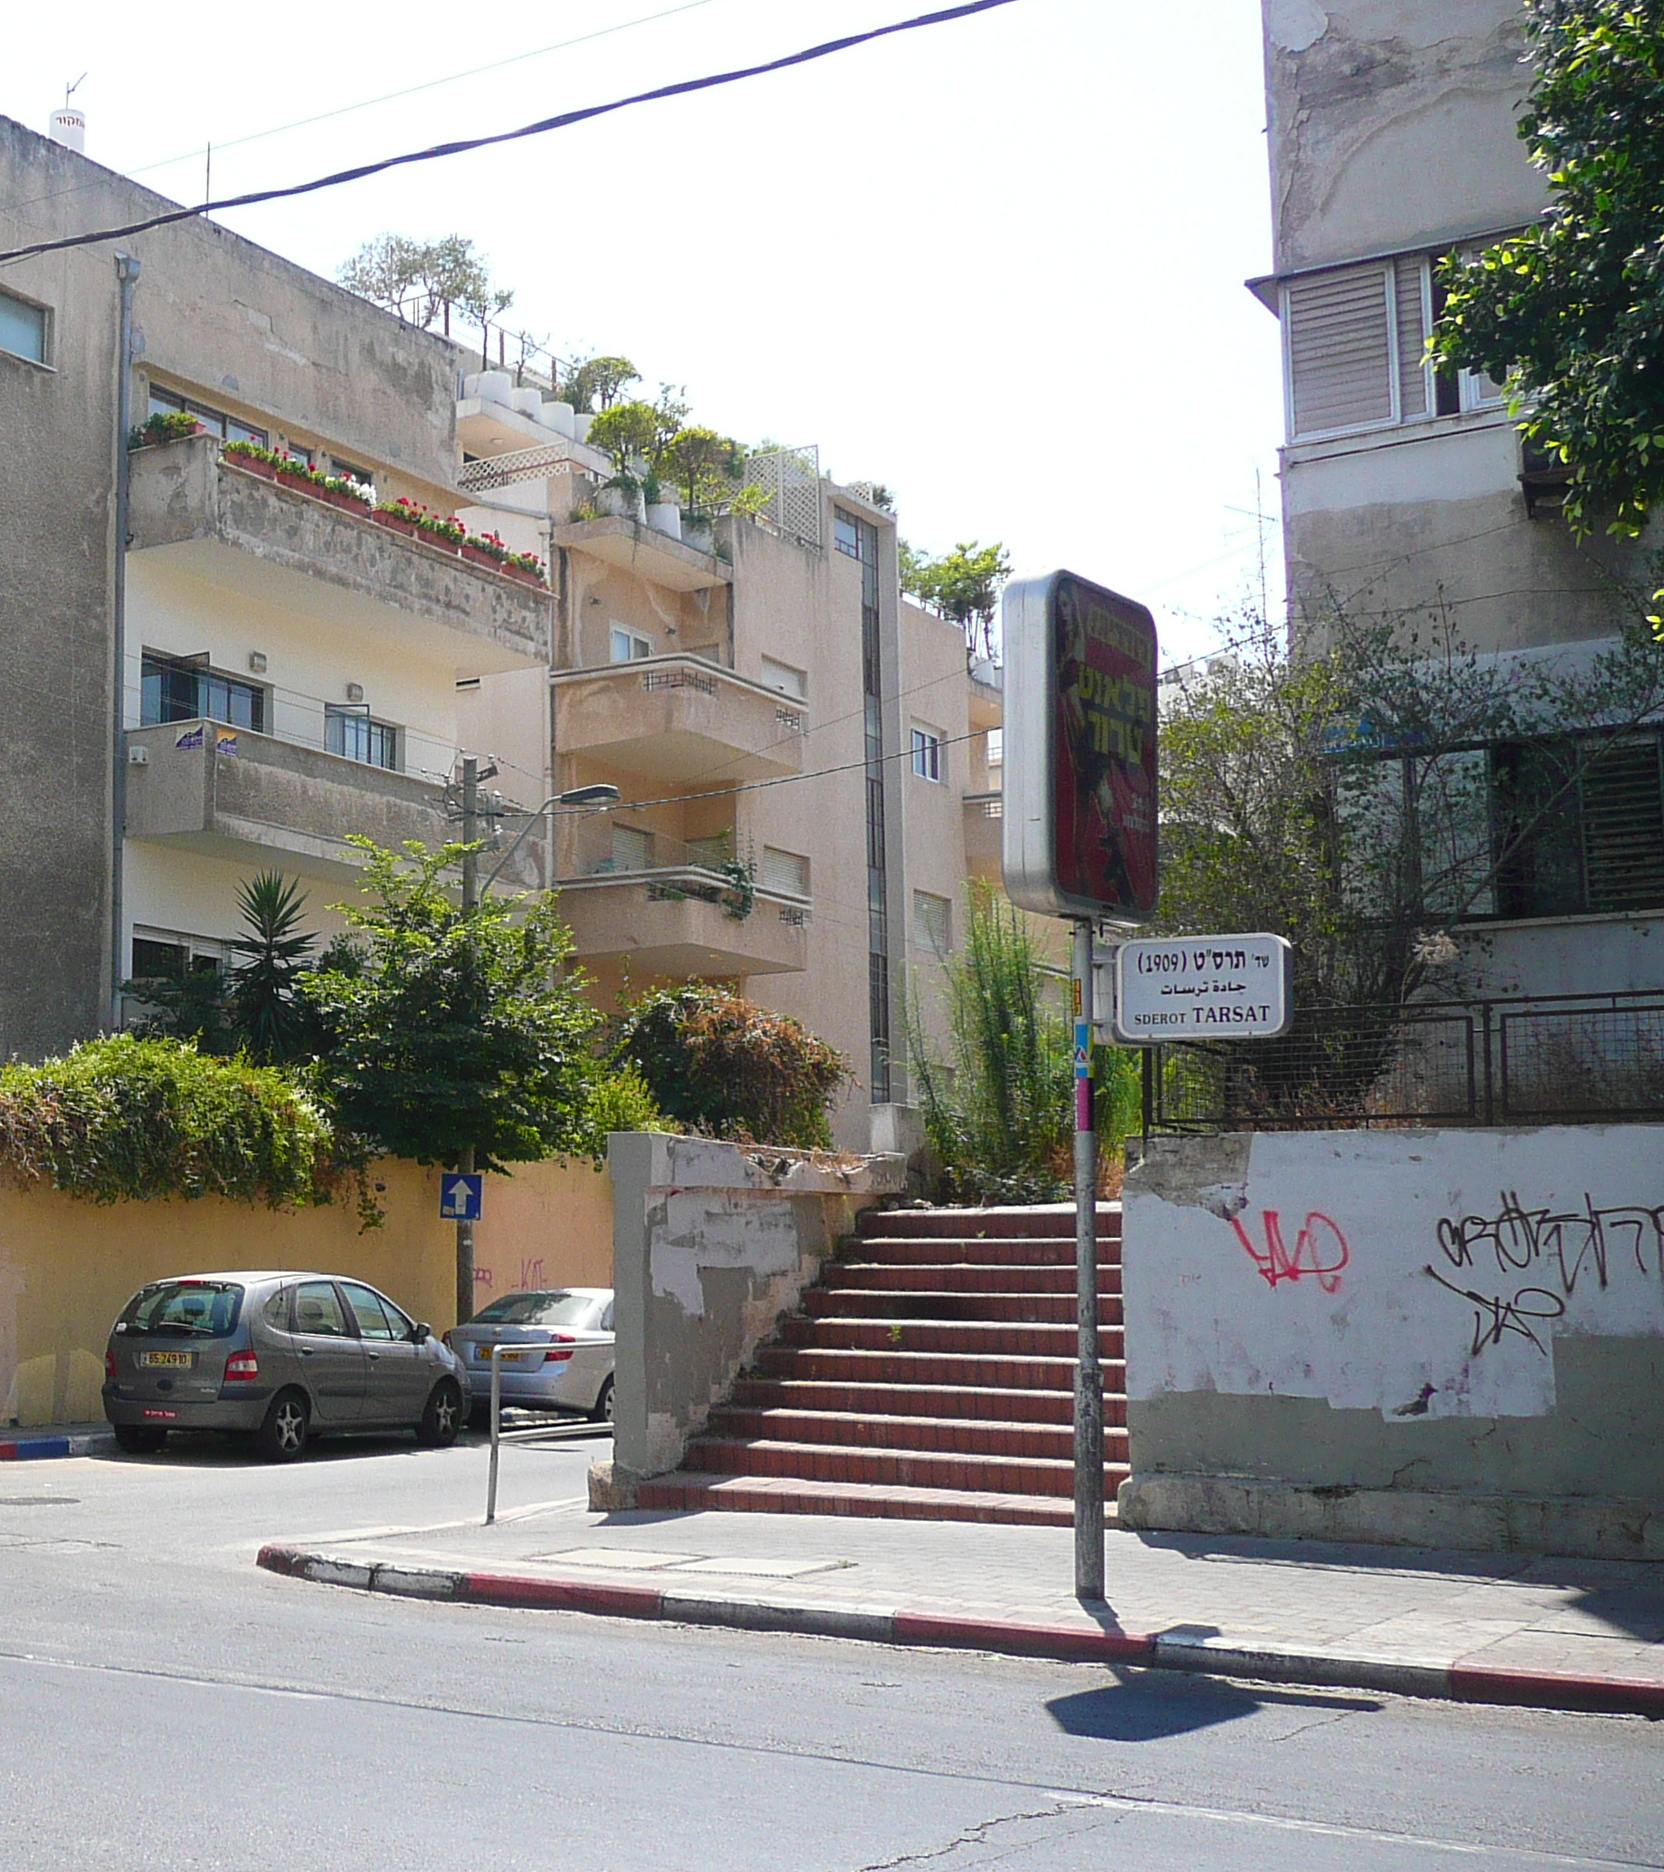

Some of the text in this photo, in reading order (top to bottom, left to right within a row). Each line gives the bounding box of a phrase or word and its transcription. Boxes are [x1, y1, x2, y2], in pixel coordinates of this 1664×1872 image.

[1138, 950, 1187, 974] (1909)
[1193, 948, 1246, 971] תרס"ט
[1160, 979, 1246, 997] جادة ترسات
[1134, 1005, 1270, 1026] SDEROT TARSAT
